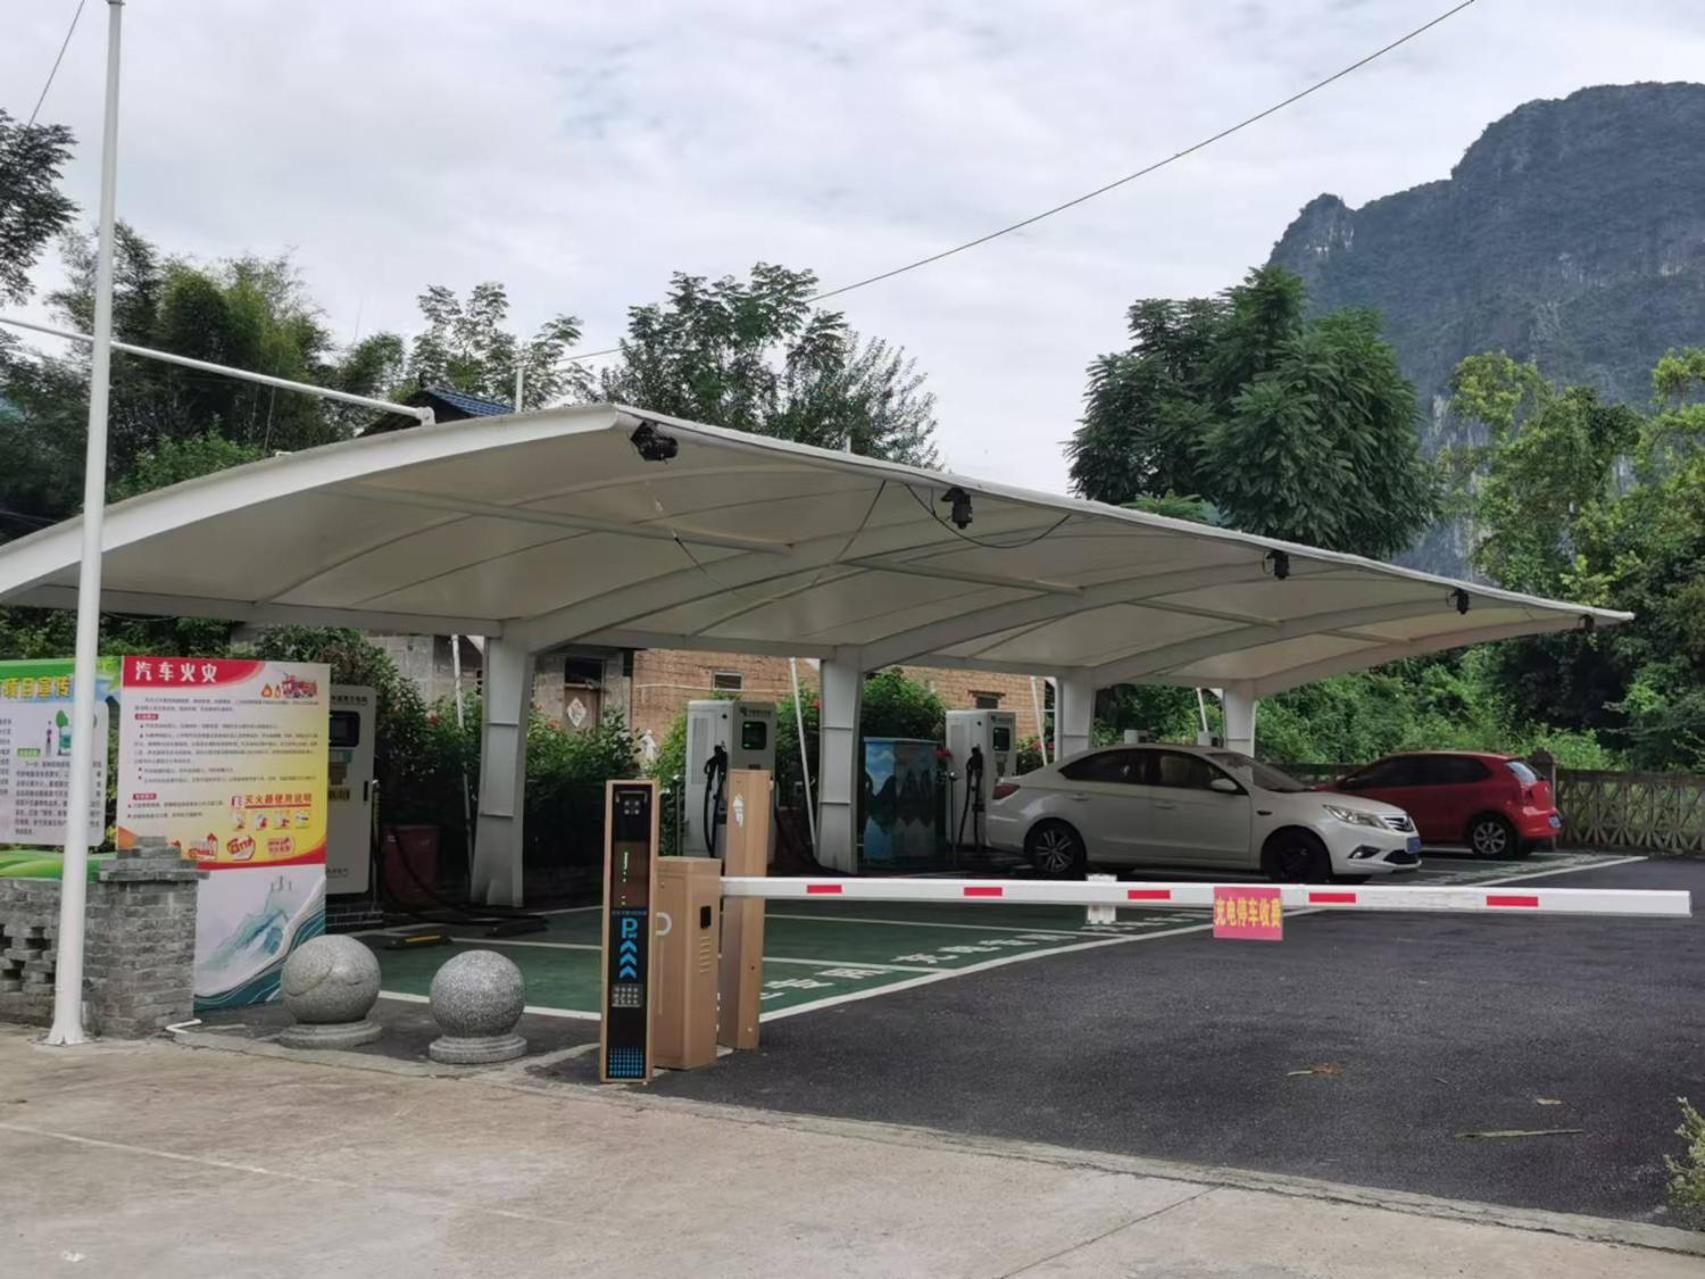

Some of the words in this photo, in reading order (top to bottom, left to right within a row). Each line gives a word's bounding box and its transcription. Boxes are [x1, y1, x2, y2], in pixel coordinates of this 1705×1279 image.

[135, 661, 217, 683] 汽车火灾
[245, 792, 313, 804] 灭火器使用说明
[1216, 896, 1282, 928] 充电停车收费
